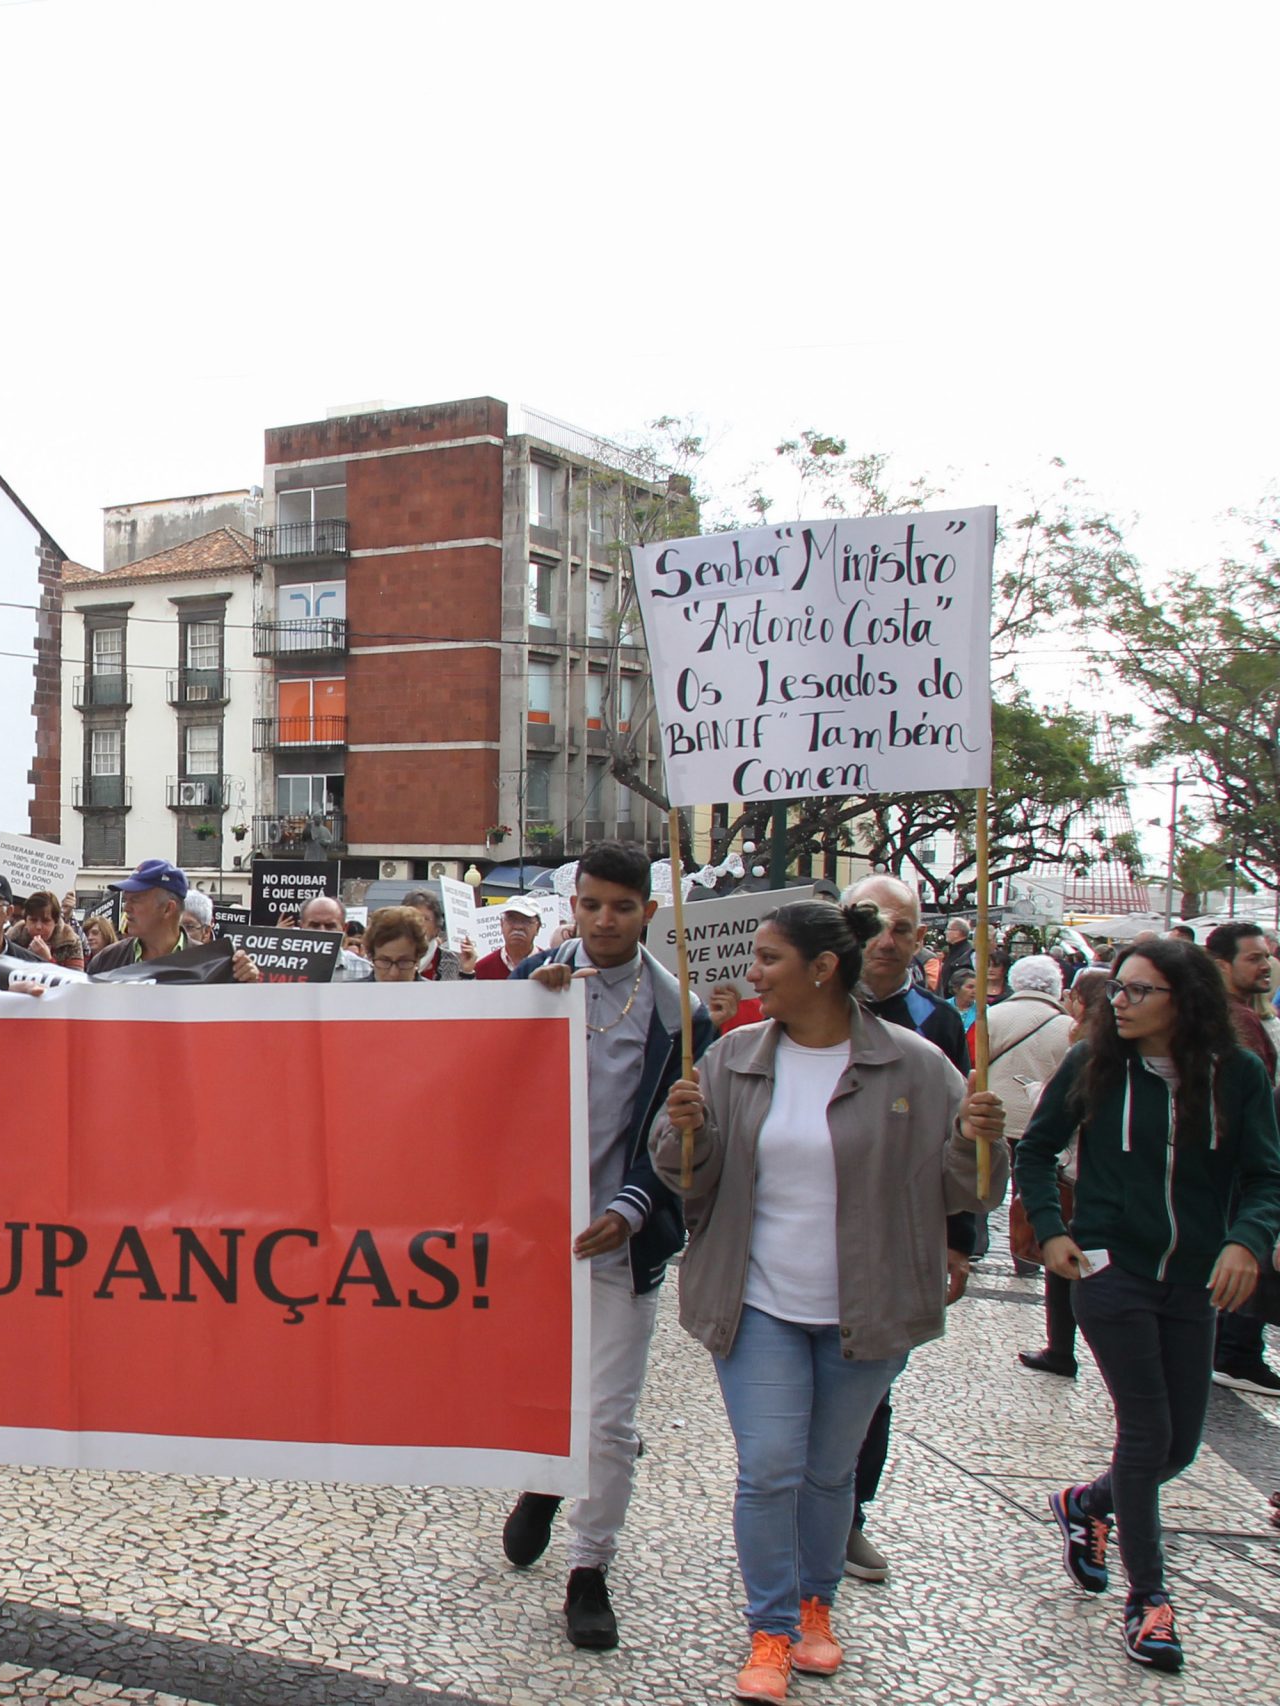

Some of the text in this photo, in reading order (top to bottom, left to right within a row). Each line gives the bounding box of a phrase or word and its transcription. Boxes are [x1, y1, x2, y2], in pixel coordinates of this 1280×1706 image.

[651, 540, 790, 598] Senhor
[676, 653, 964, 713] Os Lesados do
[799, 708, 982, 755] Também
[732, 758, 879, 797] Comem
[30, 859, 58, 870] SEGURO
[46, 854, 61, 863] QUE
[61, 858, 75, 867] ERA
[2, 859, 31, 871] PORQUE
[38, 868, 65, 880] ESTADO
[10, 869, 24, 878] ERA
[32, 874, 52, 884] DONO
[10, 877, 46, 891] DO BANCO
[262, 874, 327, 885] NO ROUBAR
[262, 887, 270, 898] É
[272, 889, 295, 899] QUE
[268, 902, 302, 913] O GAN
[215, 912, 246, 922] SERVE
[666, 918, 760, 945] SANTAND
[245, 935, 279, 950] QUE
[280, 938, 334, 954] SERVE
[248, 953, 308, 970] OUPAR?
[705, 962, 752, 983] SAVI
